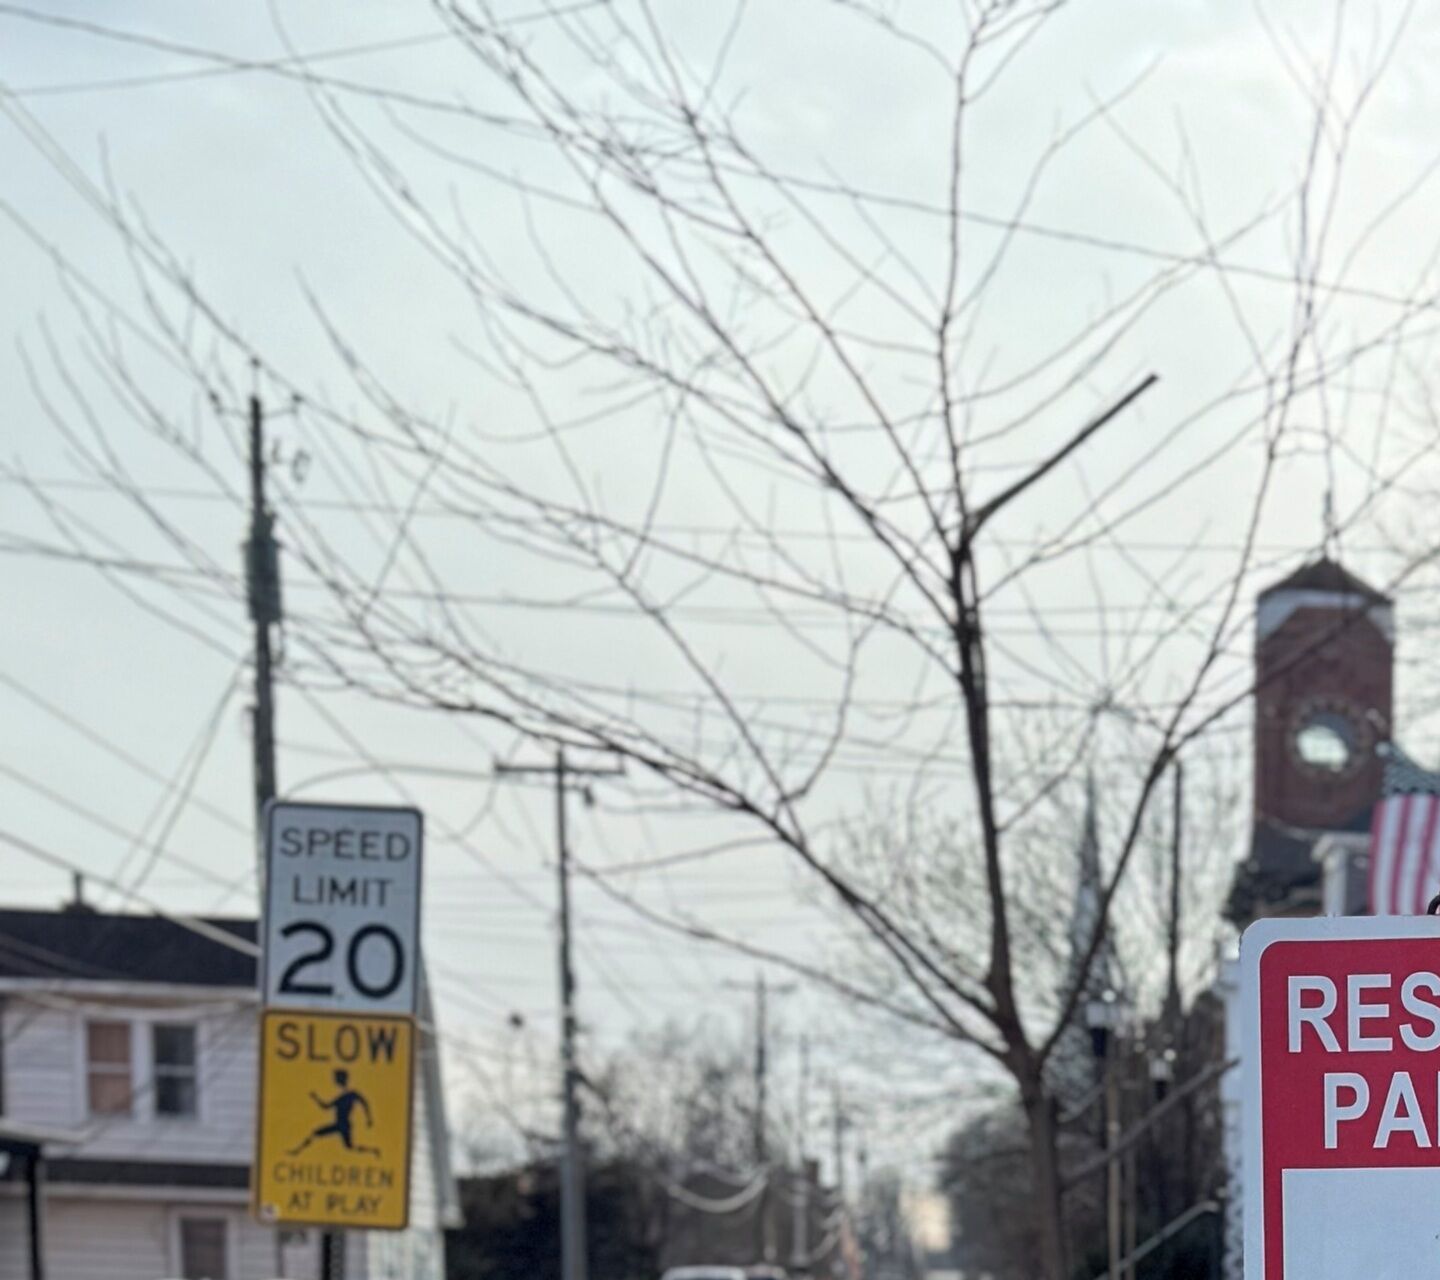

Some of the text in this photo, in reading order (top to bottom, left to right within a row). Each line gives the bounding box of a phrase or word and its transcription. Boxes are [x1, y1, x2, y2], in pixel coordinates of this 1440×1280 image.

[279, 826, 411, 862] SPEED
[293, 874, 393, 908] LIMIT
[277, 920, 405, 1000] 20
[275, 1021, 397, 1064] SLOW
[272, 1160, 394, 1190] CHILDREN
[287, 1191, 384, 1217] AT PLAY
